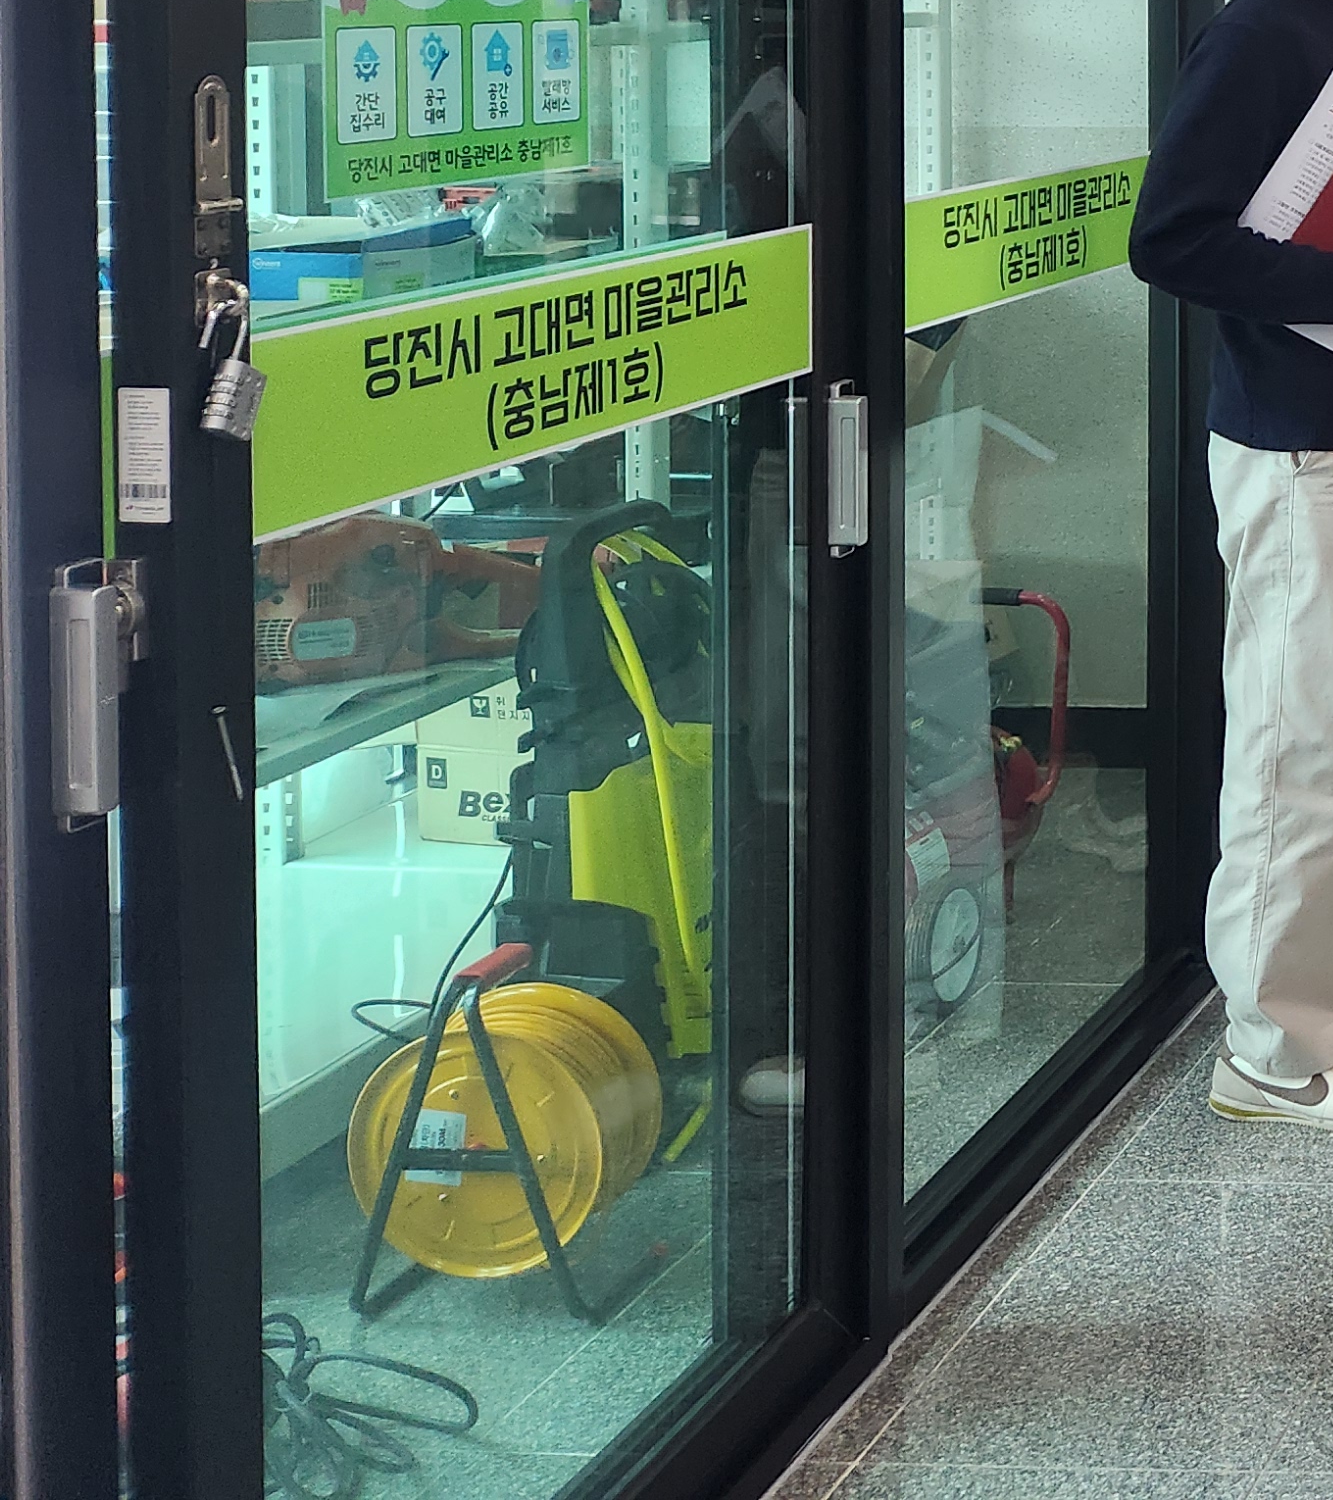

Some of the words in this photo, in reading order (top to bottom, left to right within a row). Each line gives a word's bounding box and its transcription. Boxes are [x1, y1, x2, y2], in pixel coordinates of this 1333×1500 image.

[424, 88, 447, 107] 공구
[488, 81, 509, 100] 공간
[355, 92, 380, 112] 간단
[488, 101, 509, 120] 공유
[541, 97, 571, 114] 서비스
[350, 112, 385, 133] 집수리
[424, 107, 446, 125] 대여
[348, 154, 393, 184] 당진시
[398, 150, 441, 175] 고대면
[445, 143, 513, 170] 마을관리소
[517, 135, 573, 163] 충남제1호
[943, 197, 998, 249] 당진시
[1003, 185, 1053, 234] 고대면
[1057, 171, 1131, 221] 마을관리소
[1000, 225, 1087, 291] (충남제1호)
[364, 314, 482, 400] 당진시
[493, 290, 596, 367] 고대면
[604, 259, 748, 340] 마을관리소
[487, 341, 665, 452] (충남제1호)
[431, 764, 442, 780] D
